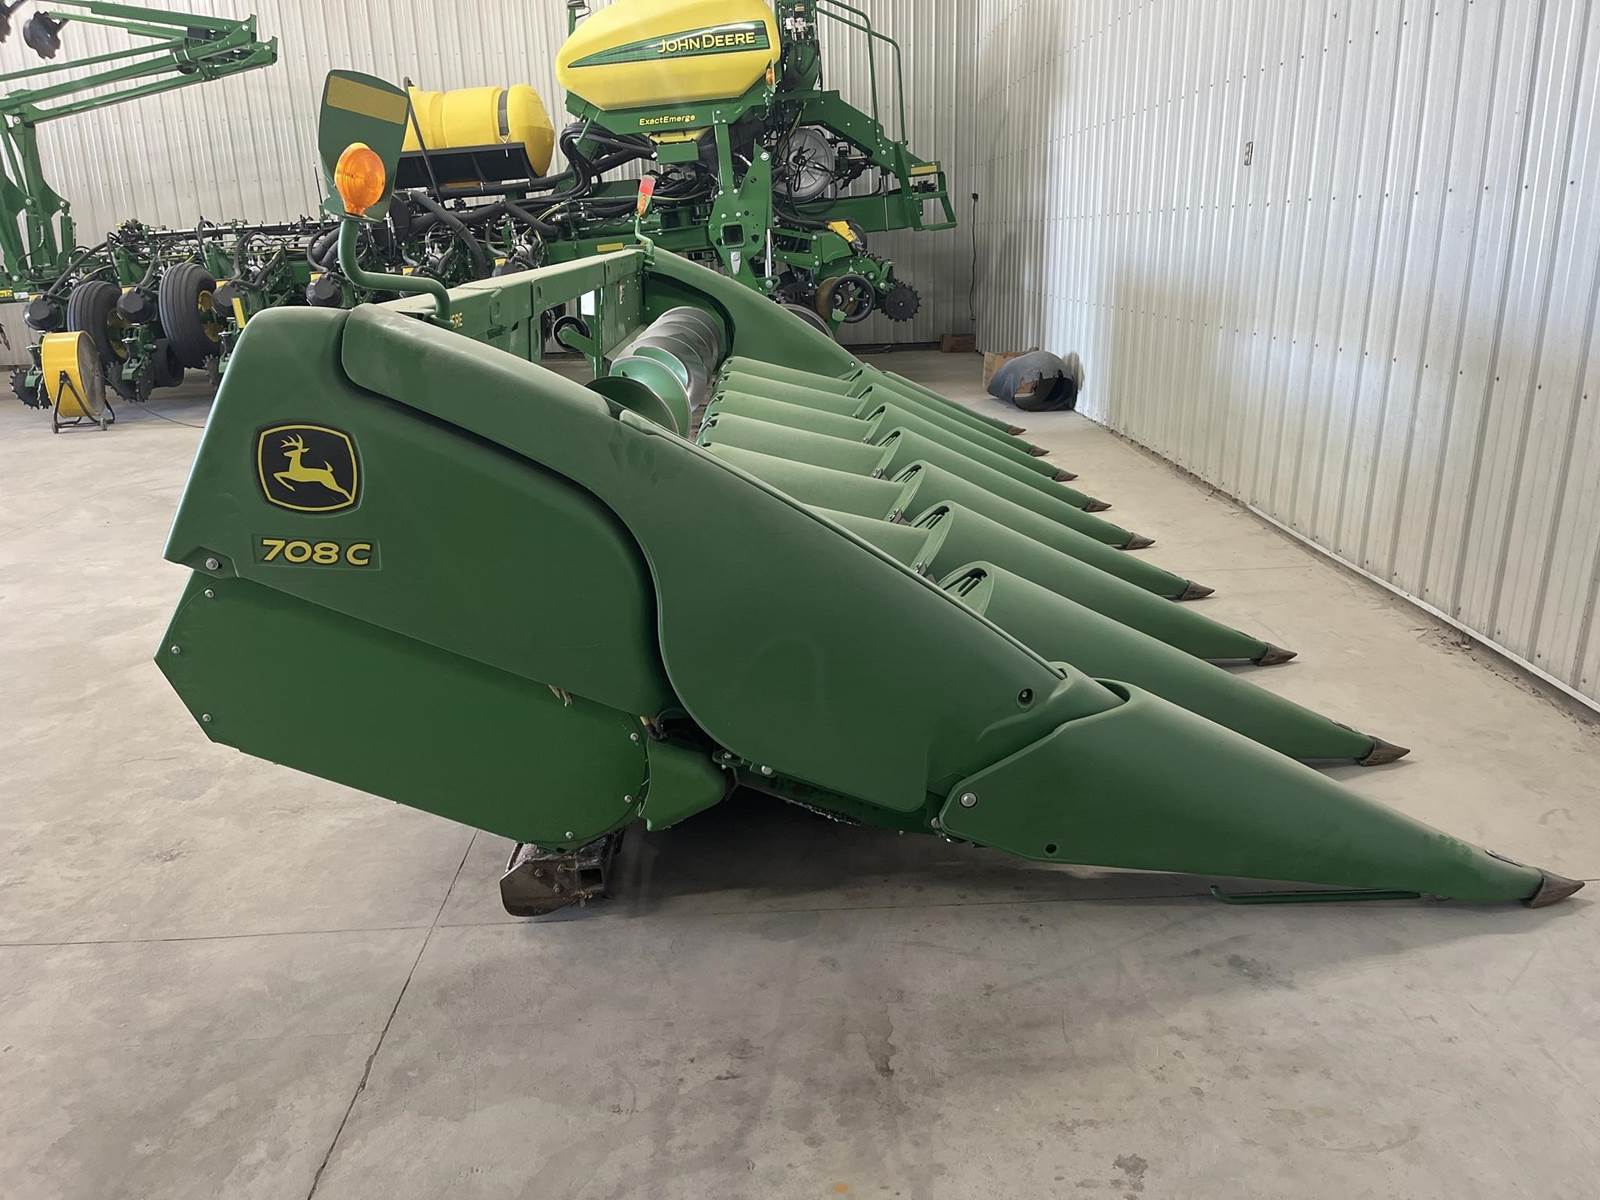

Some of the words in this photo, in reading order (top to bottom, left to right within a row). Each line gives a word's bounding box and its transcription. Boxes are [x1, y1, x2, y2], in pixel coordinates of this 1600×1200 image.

[657, 37, 700, 53] JOHN
[702, 31, 756, 49] DEERE
[639, 114, 696, 126] ExactEmerge
[261, 538, 340, 565] 708
[346, 542, 372, 566] C
